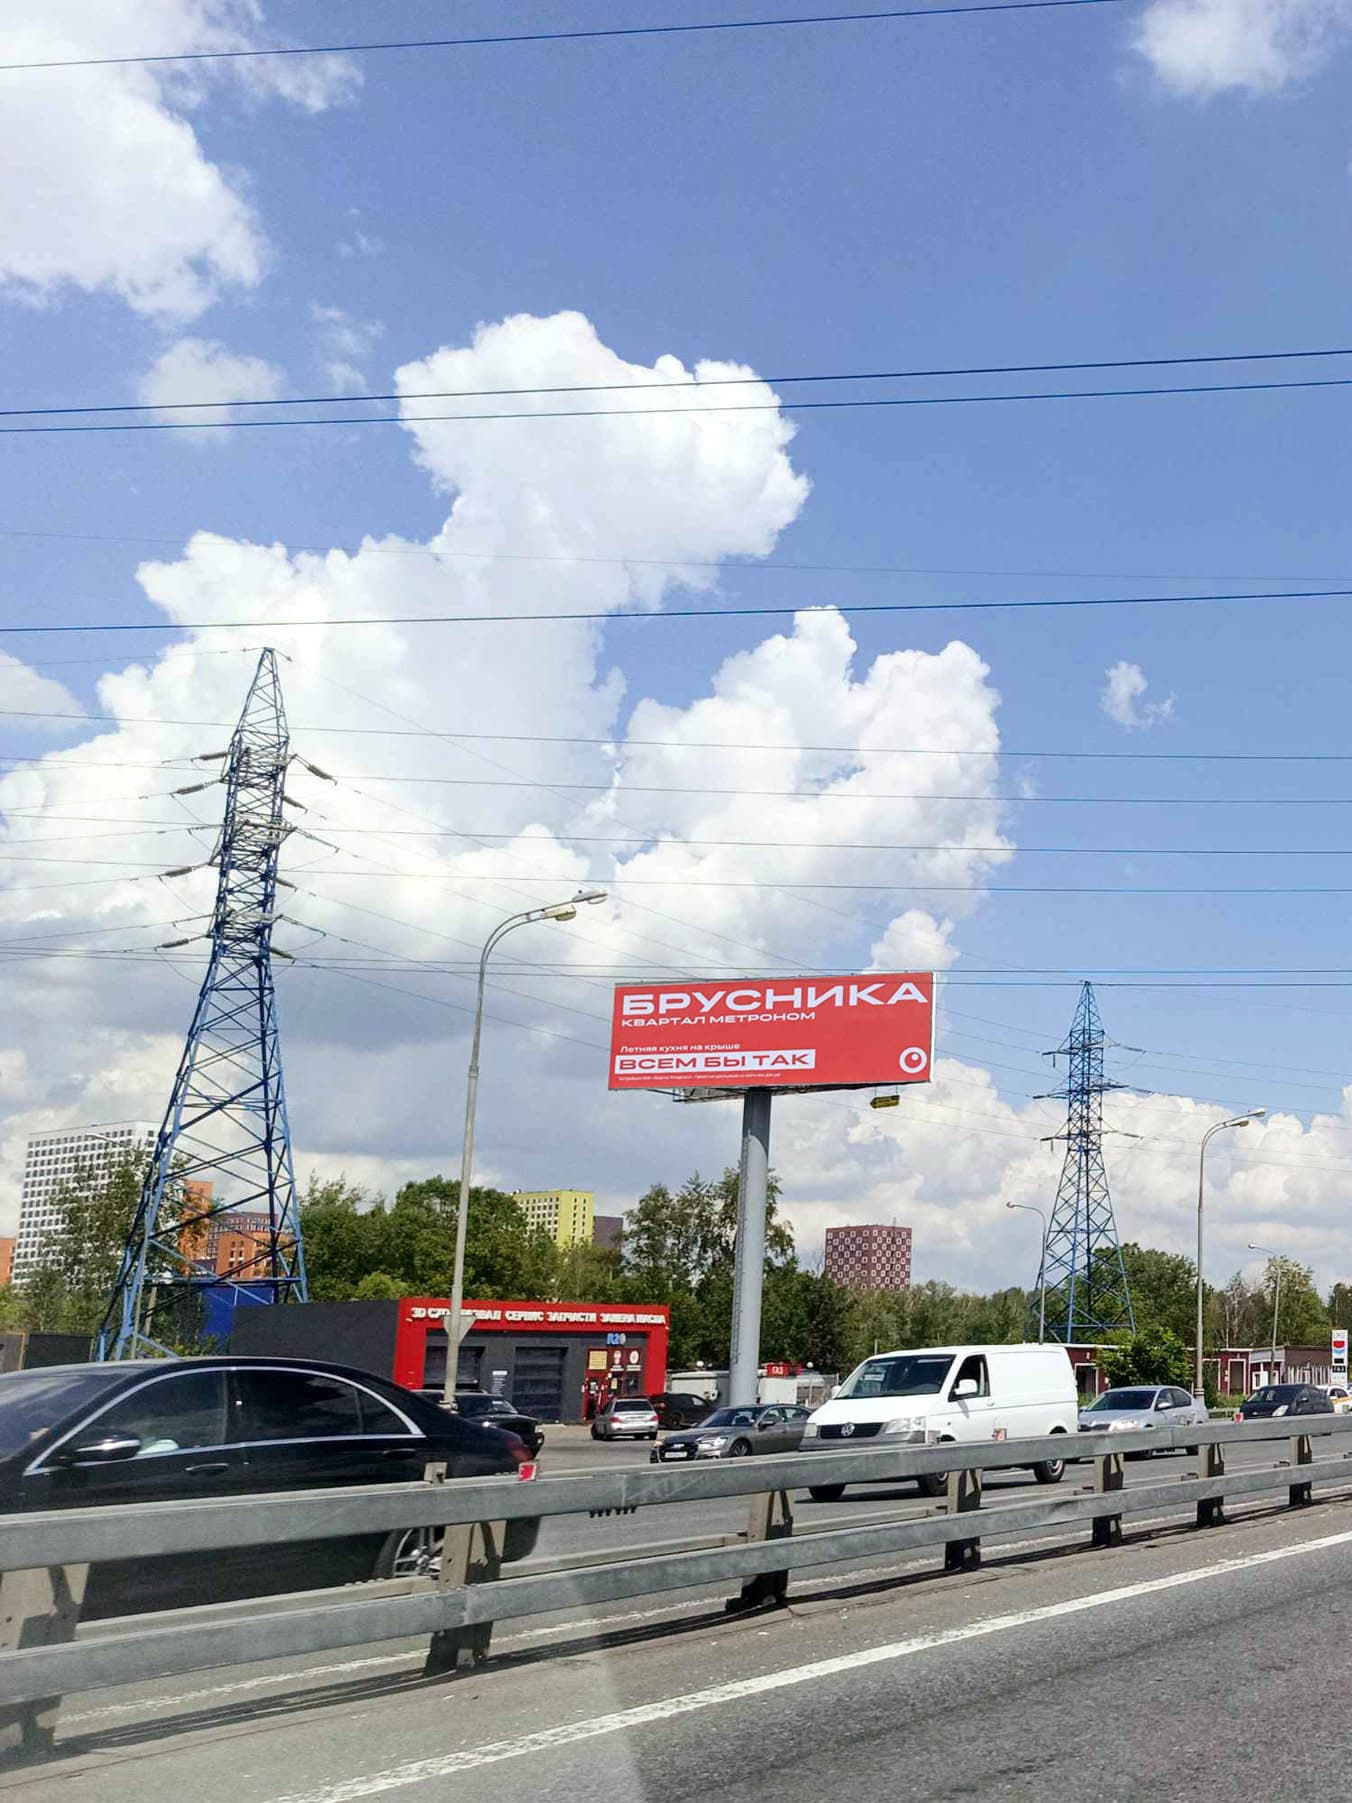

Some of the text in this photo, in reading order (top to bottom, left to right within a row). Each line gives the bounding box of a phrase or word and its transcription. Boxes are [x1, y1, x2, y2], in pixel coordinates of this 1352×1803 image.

[622, 982, 929, 1016] БРУСНИКА
[622, 1012, 816, 1027] КВАРТАЛ МЕТРОНОМ
[620, 1045, 657, 1053] Летняя
[659, 1044, 688, 1053] кухня
[705, 1043, 741, 1051] крыше
[619, 1054, 809, 1070] ВСЕМ БЫ ТАК
[505, 1310, 544, 1322] СЕРВИС
[546, 1311, 597, 1323] ЗАПЧАСТИ
